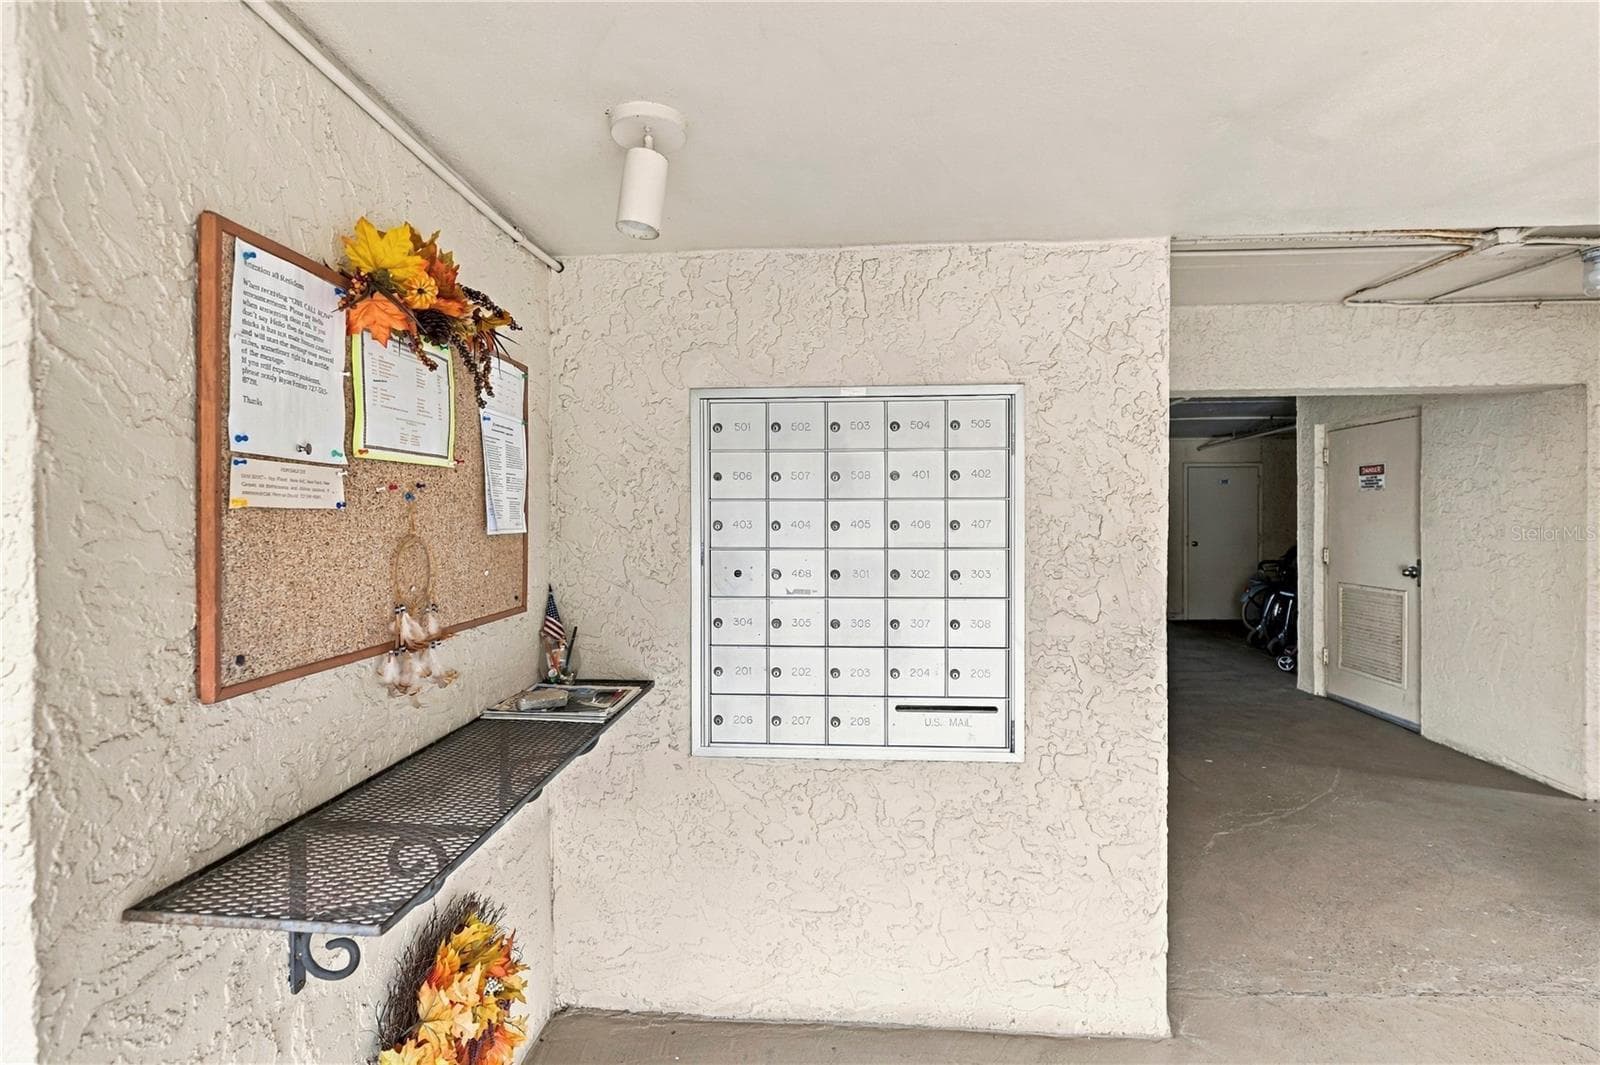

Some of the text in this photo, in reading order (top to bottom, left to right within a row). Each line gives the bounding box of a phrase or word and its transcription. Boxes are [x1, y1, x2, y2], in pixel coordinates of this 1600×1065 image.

[243, 278, 260, 291] When
[261, 287, 288, 302] receiving
[303, 303, 316, 314] CALL
[243, 299, 258, 309] when
[242, 308, 257, 319] don't
[259, 315, 268, 324] say
[270, 317, 286, 328] Hello
[241, 329, 253, 337] and
[254, 332, 265, 340] will
[279, 340, 289, 348] the
[249, 349, 259, 358] the
[248, 359, 259, 367] you
[243, 395, 263, 406] Thanks
[733, 422, 751, 431] 501
[790, 421, 811, 431] 502
[849, 420, 870, 430] 503
[909, 419, 930, 430] 504
[970, 418, 991, 428] 505
[732, 470, 752, 480] 506
[790, 470, 810, 480] 507
[850, 470, 870, 480] 508
[911, 469, 929, 479] 401
[970, 468, 991, 478] 402
[732, 519, 752, 529] 403
[790, 519, 811, 529] 404
[849, 519, 871, 529] 405
[909, 519, 931, 529] 406
[970, 519, 991, 528] 407
[791, 568, 811, 578] 408
[851, 568, 869, 578] 301
[909, 568, 930, 579] 302
[970, 568, 991, 578] 303
[732, 617, 752, 626] 304
[791, 617, 811, 627] 305
[850, 618, 871, 628] 306
[909, 618, 930, 628] 307
[969, 618, 991, 629] 308
[735, 665, 751, 675] 201
[791, 666, 811, 676] 202
[849, 667, 870, 677] 203
[909, 667, 929, 677] 204
[970, 668, 990, 678] 205
[732, 714, 753, 724] 206
[791, 715, 811, 725] 207
[849, 716, 870, 726] 208
[949, 718, 973, 728] MAIL
